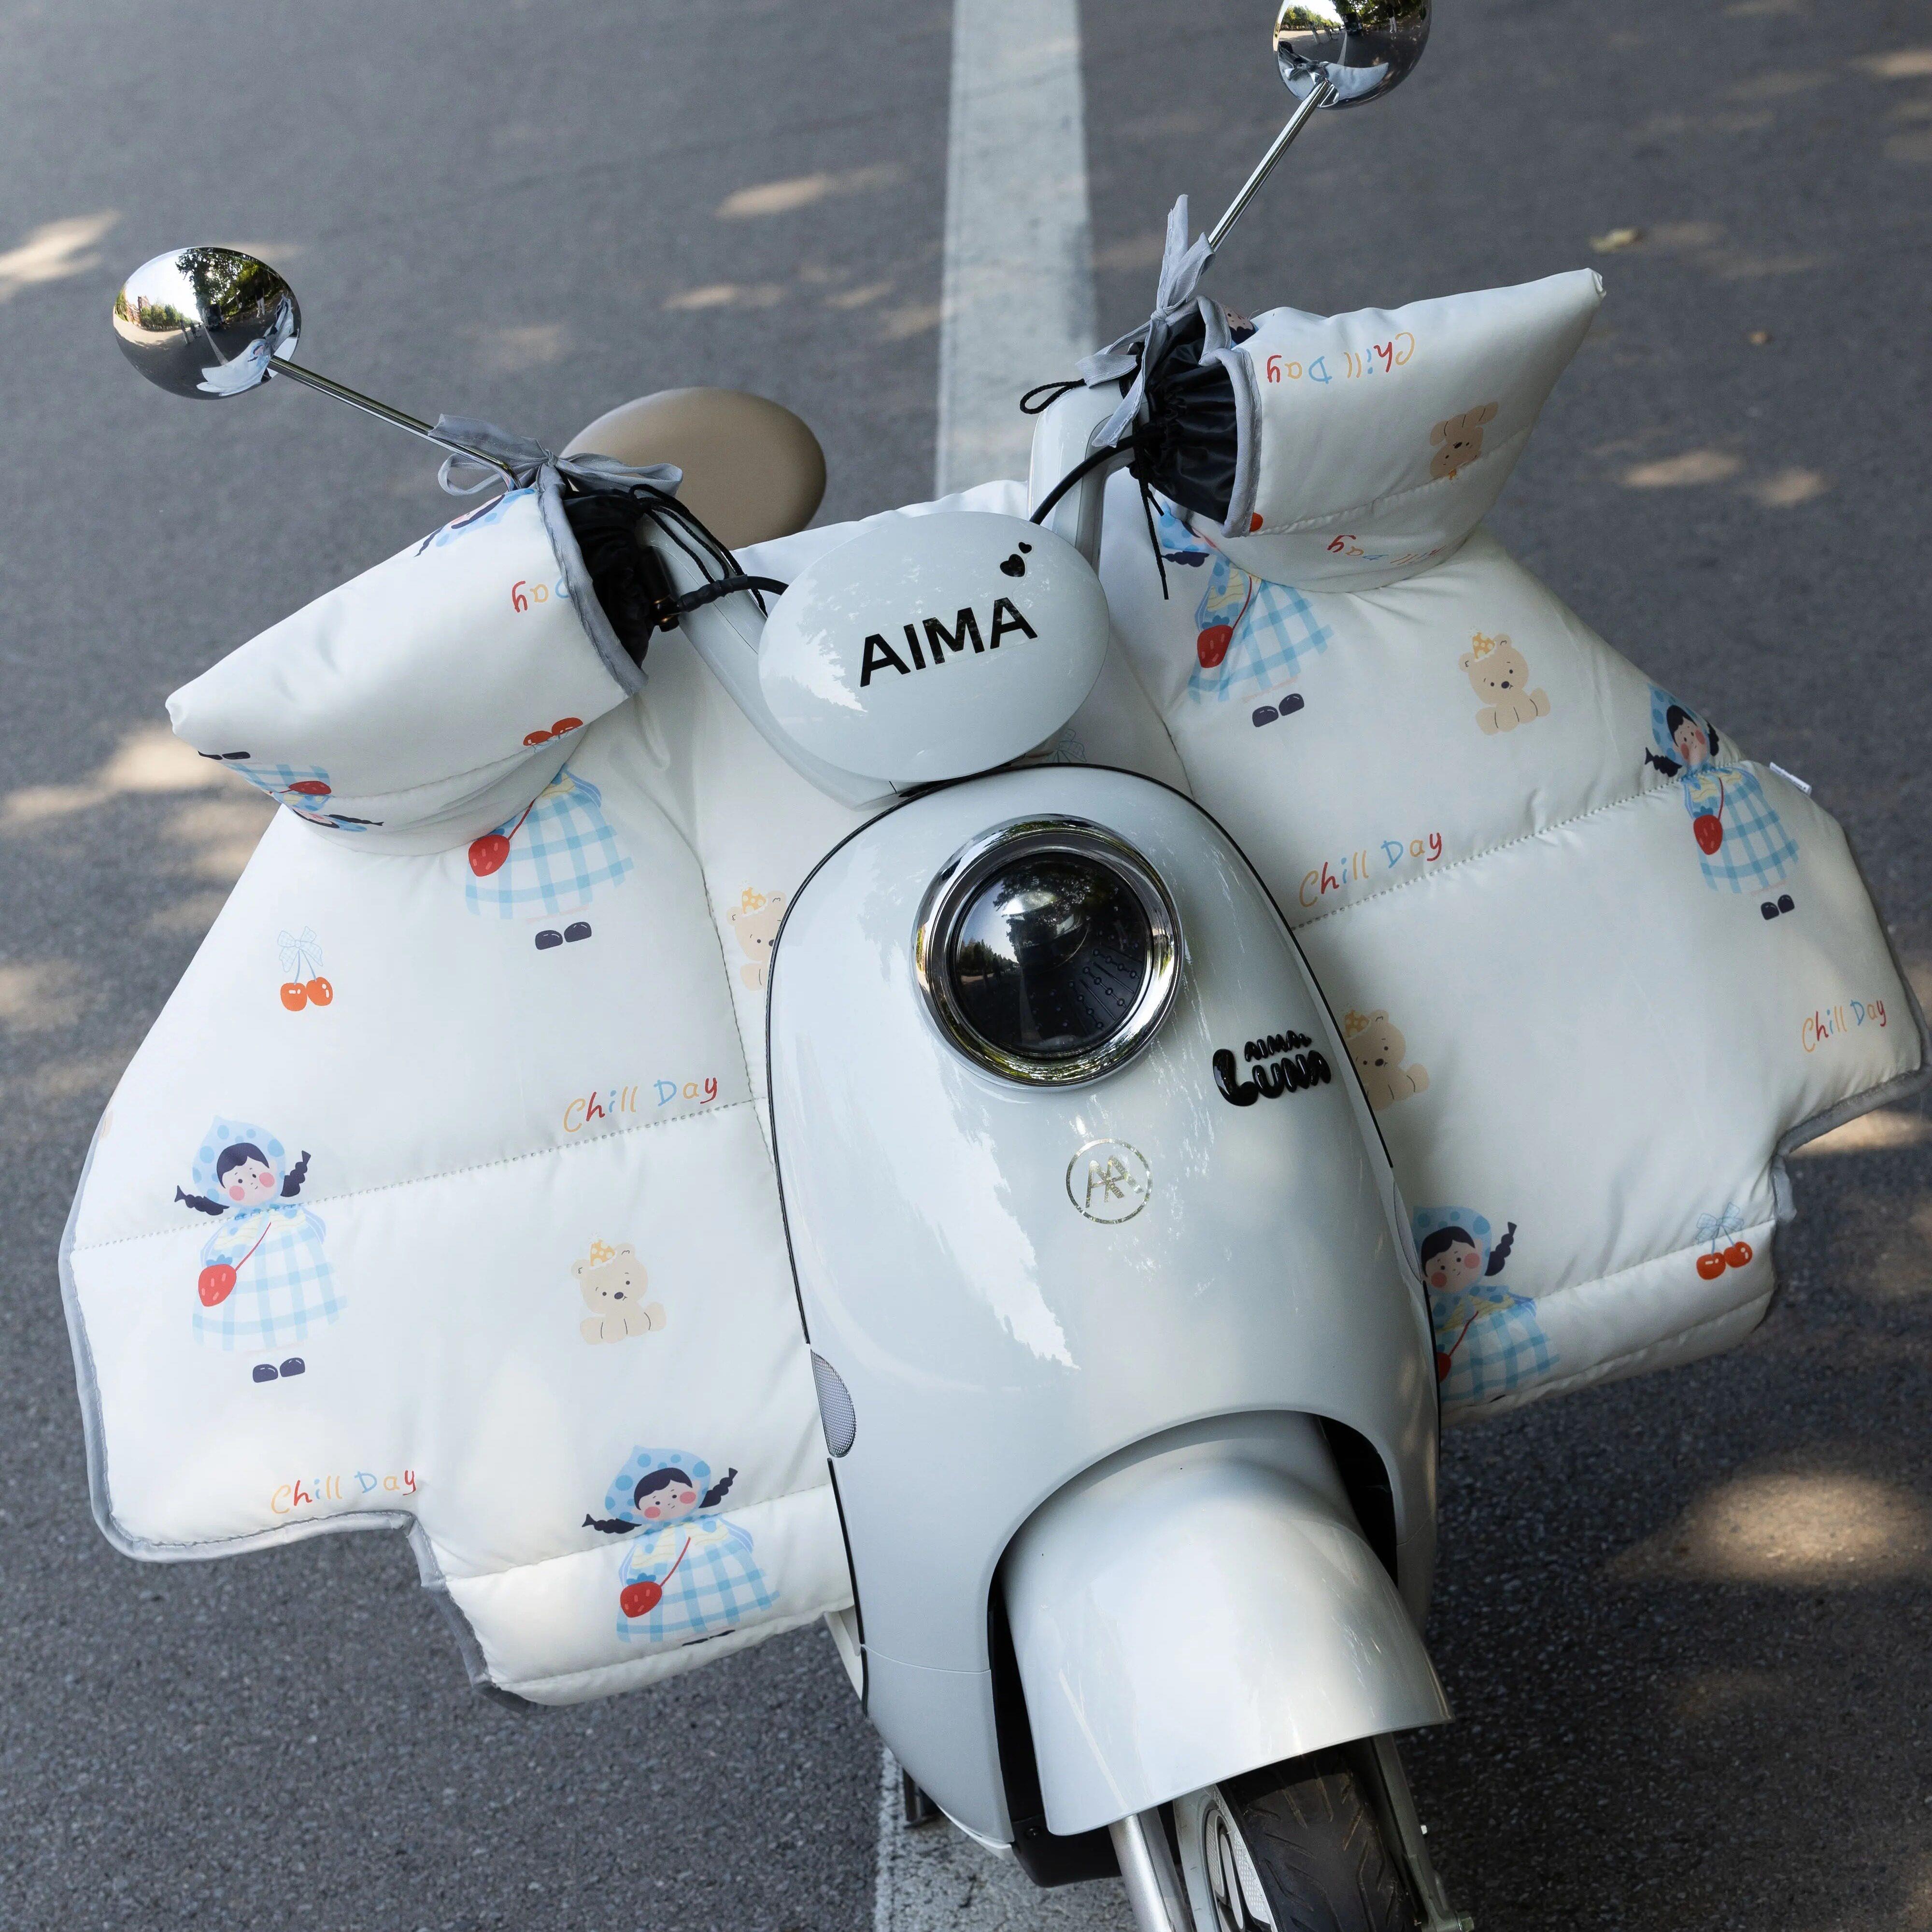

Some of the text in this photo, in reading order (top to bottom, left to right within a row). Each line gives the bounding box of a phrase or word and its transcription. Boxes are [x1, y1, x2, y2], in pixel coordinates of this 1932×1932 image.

[1266, 332, 1415, 384] Chill Day
[860, 597, 1038, 688] AIMA
[1299, 832, 1442, 908] Chill Day
[1802, 999, 1886, 1052] Chill Day
[563, 1077, 718, 1133] Chill Day
[270, 1470, 416, 1514] Chill Day
